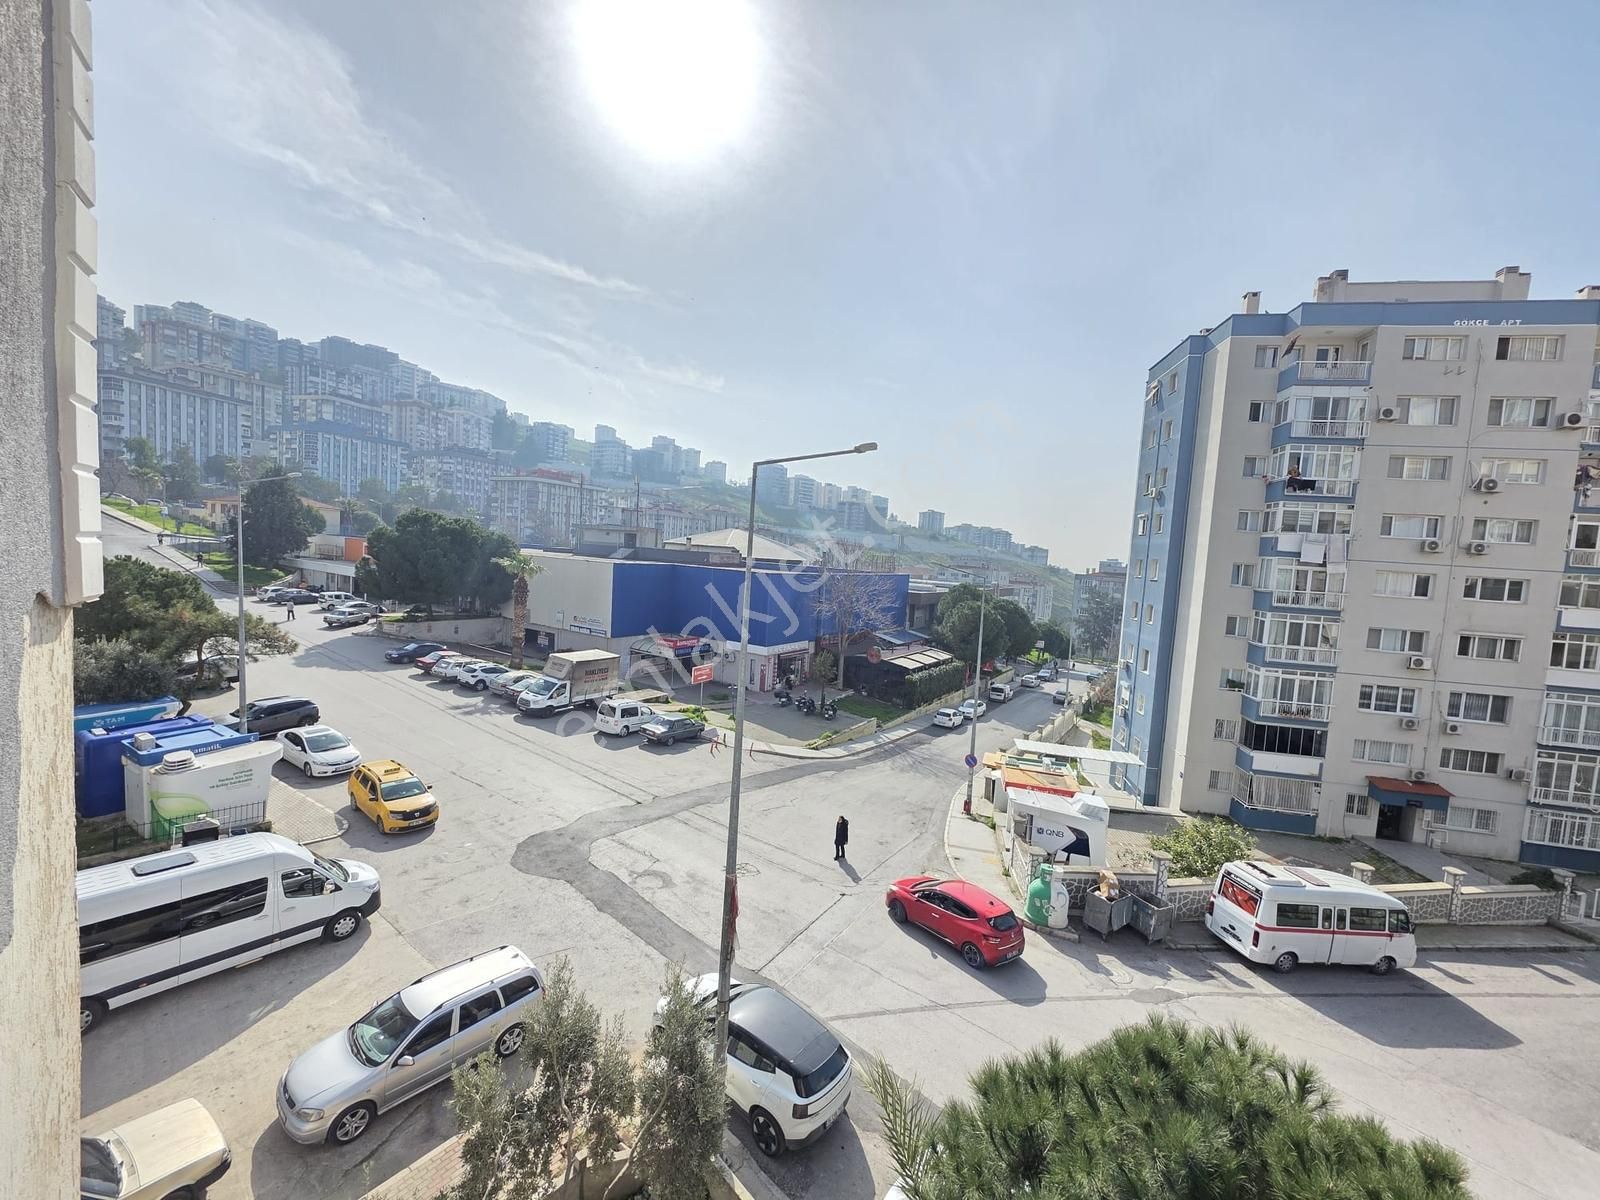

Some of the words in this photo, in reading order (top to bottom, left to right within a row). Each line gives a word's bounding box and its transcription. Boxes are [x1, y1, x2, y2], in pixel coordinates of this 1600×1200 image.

[1500, 319, 1522, 327] APT
[104, 716, 126, 724] TAM
[1045, 829, 1065, 838] QNB
